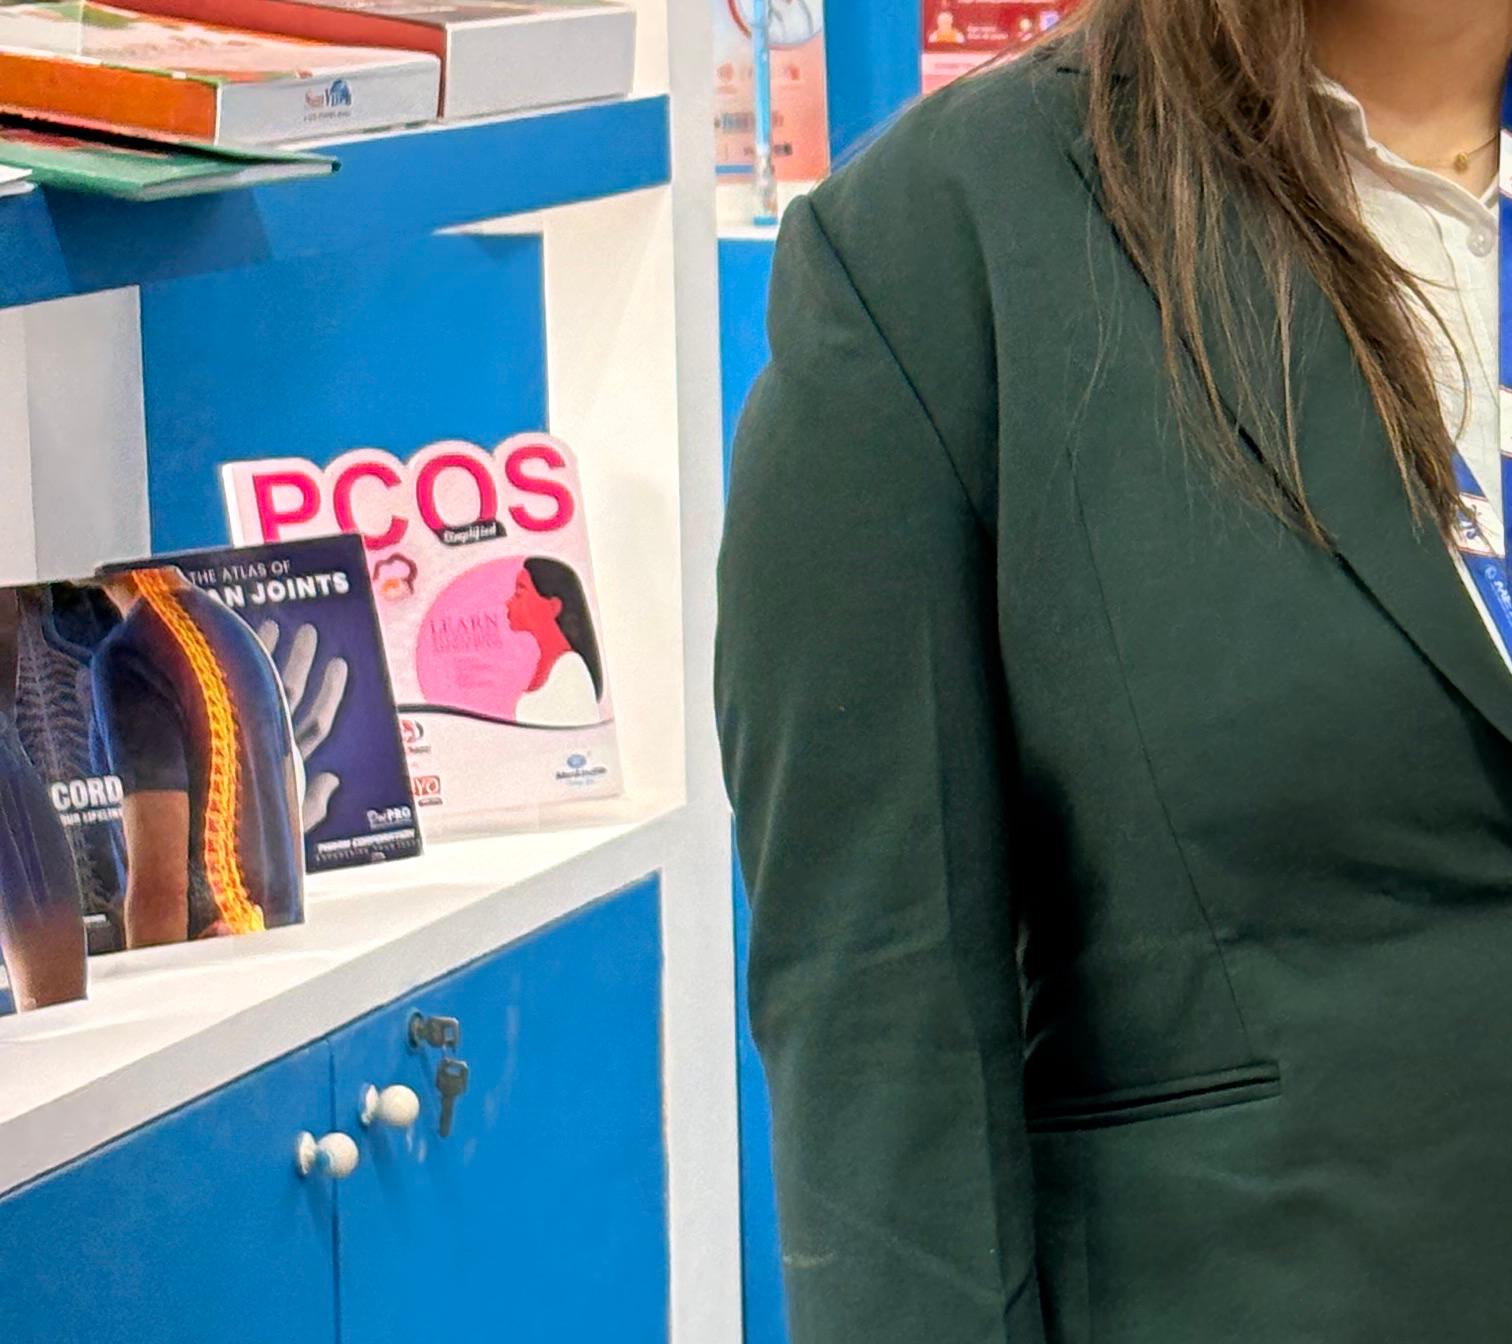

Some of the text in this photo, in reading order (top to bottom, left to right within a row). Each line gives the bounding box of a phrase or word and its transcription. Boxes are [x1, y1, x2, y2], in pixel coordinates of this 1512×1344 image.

[252, 443, 575, 551] PCOS
[188, 559, 290, 585] THE ATLAS OF
[251, 571, 350, 605] JOINTS
[51, 775, 124, 812] CORD
